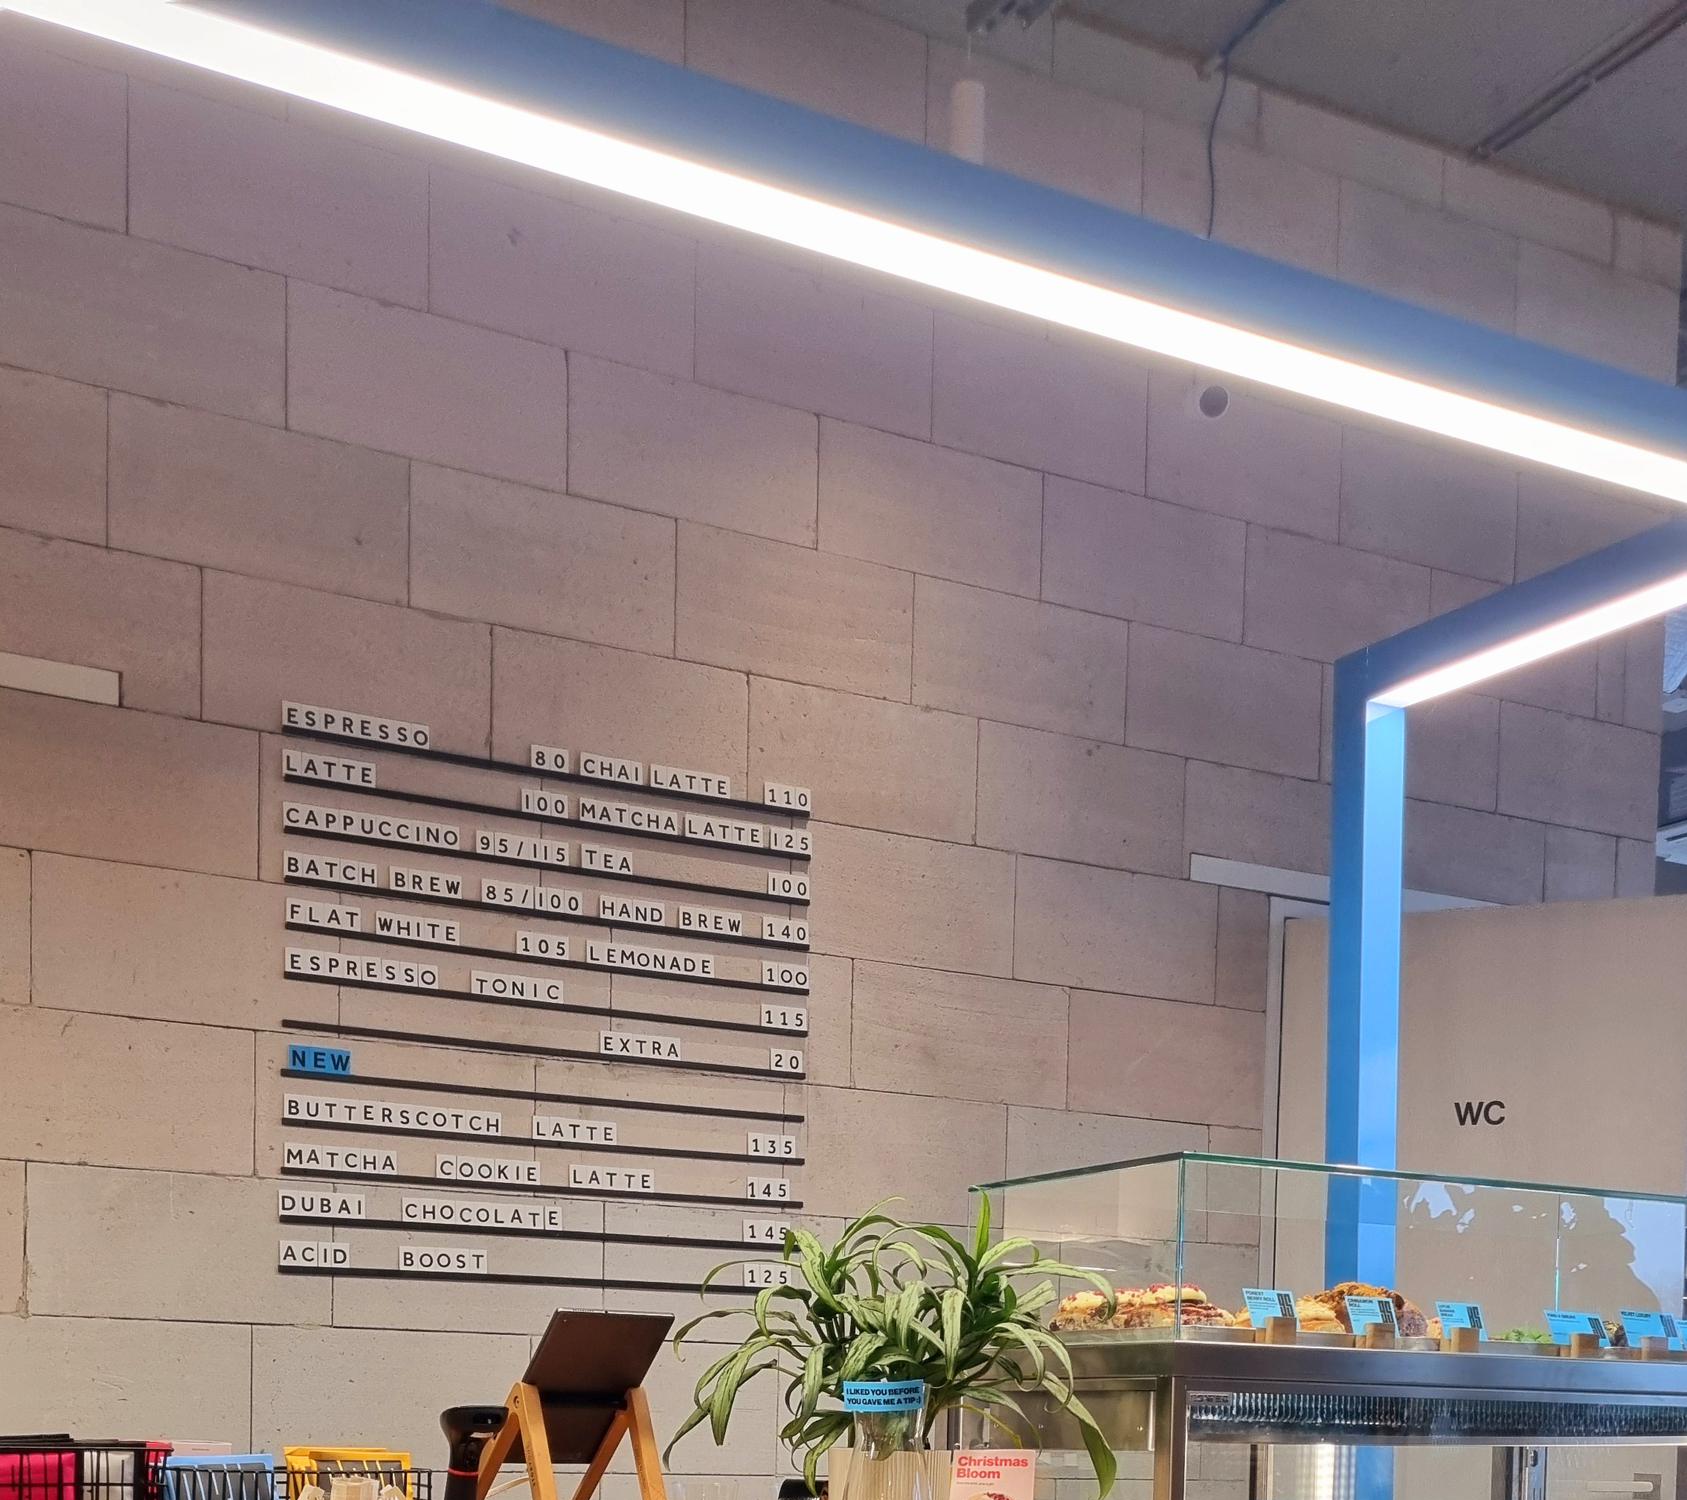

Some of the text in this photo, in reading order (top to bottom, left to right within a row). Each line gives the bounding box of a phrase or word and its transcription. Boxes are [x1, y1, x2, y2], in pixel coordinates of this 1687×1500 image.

[287, 707, 565, 769] ESPRESSO 80
[286, 755, 565, 814] LATTE 100
[584, 759, 807, 807] CHAI LATTE 110
[286, 808, 565, 862] CAPPUCCINO 95/115
[581, 803, 808, 851] MATCHA LATTE 125
[288, 857, 579, 911] BATCH BREW 85/100
[585, 850, 807, 896] TEA 100
[291, 904, 565, 956] FLAT WHITE 105
[602, 900, 806, 940] HAND BREW 140
[590, 946, 807, 985] LEMONADE 100
[290, 954, 803, 1027] ESPRESSO TONIC 115
[292, 1050, 350, 1071] NEW
[604, 1036, 799, 1069] EXTRA 20
[288, 1100, 792, 1154] BUTTERSCOTCH LATTE 135
[1454, 1101, 1505, 1125] WC
[287, 1149, 786, 1197] MATCHA COOKIE LATTE 145
[282, 1196, 786, 1240] DUBAI CHOCOLATE 145
[283, 1246, 787, 1284] ACID BOOST 125
[888, 1387, 920, 1395] BEFORE
[956, 1468, 1001, 1479] Bloom
[958, 1456, 1028, 1467] Christmas
